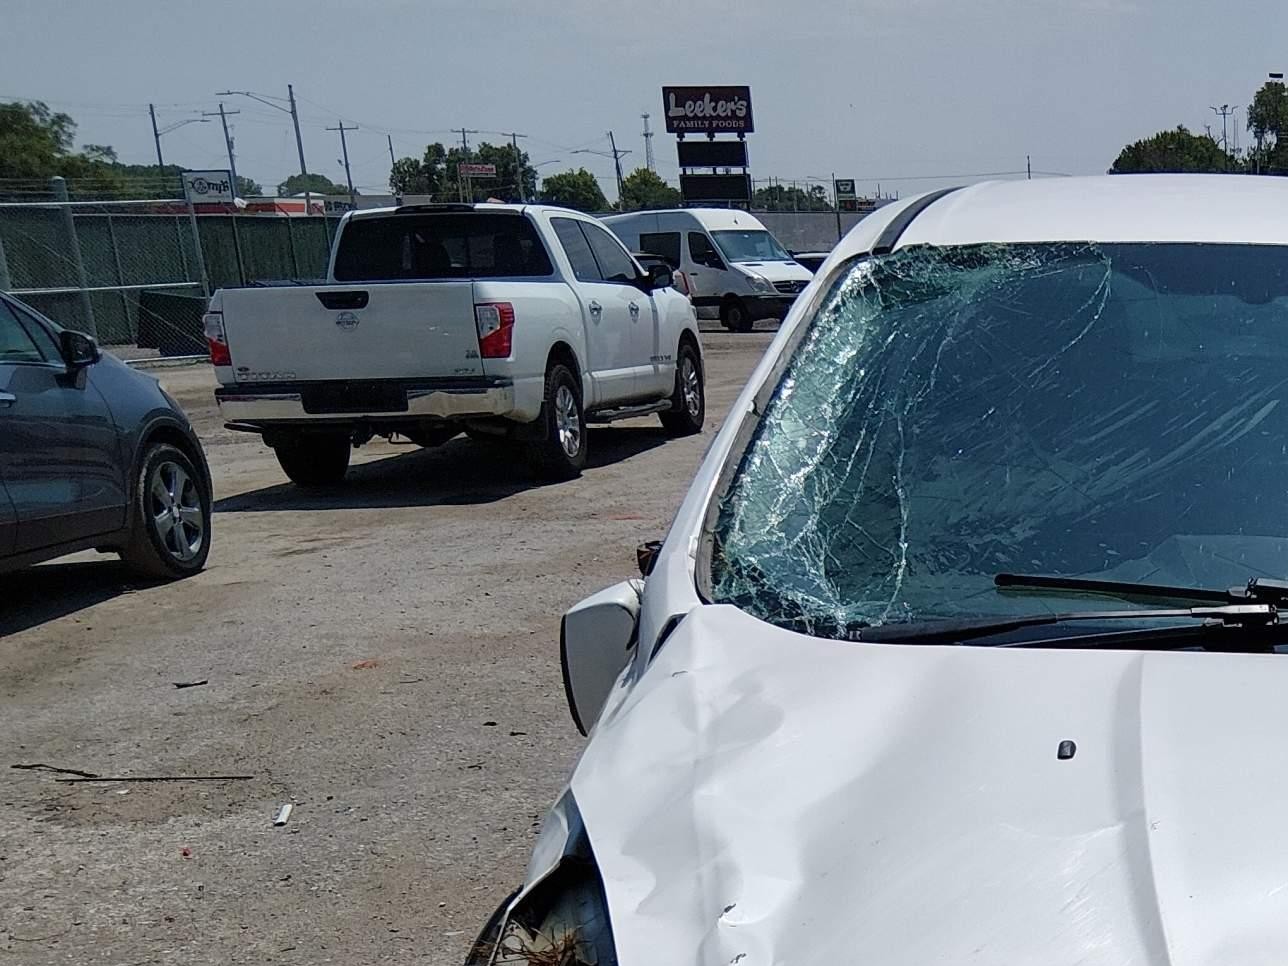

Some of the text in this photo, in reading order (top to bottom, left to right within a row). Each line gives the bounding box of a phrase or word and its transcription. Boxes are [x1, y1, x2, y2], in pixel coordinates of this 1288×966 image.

[668, 92, 747, 117] Leeker's
[673, 120, 745, 128] FAMILY FOODS
